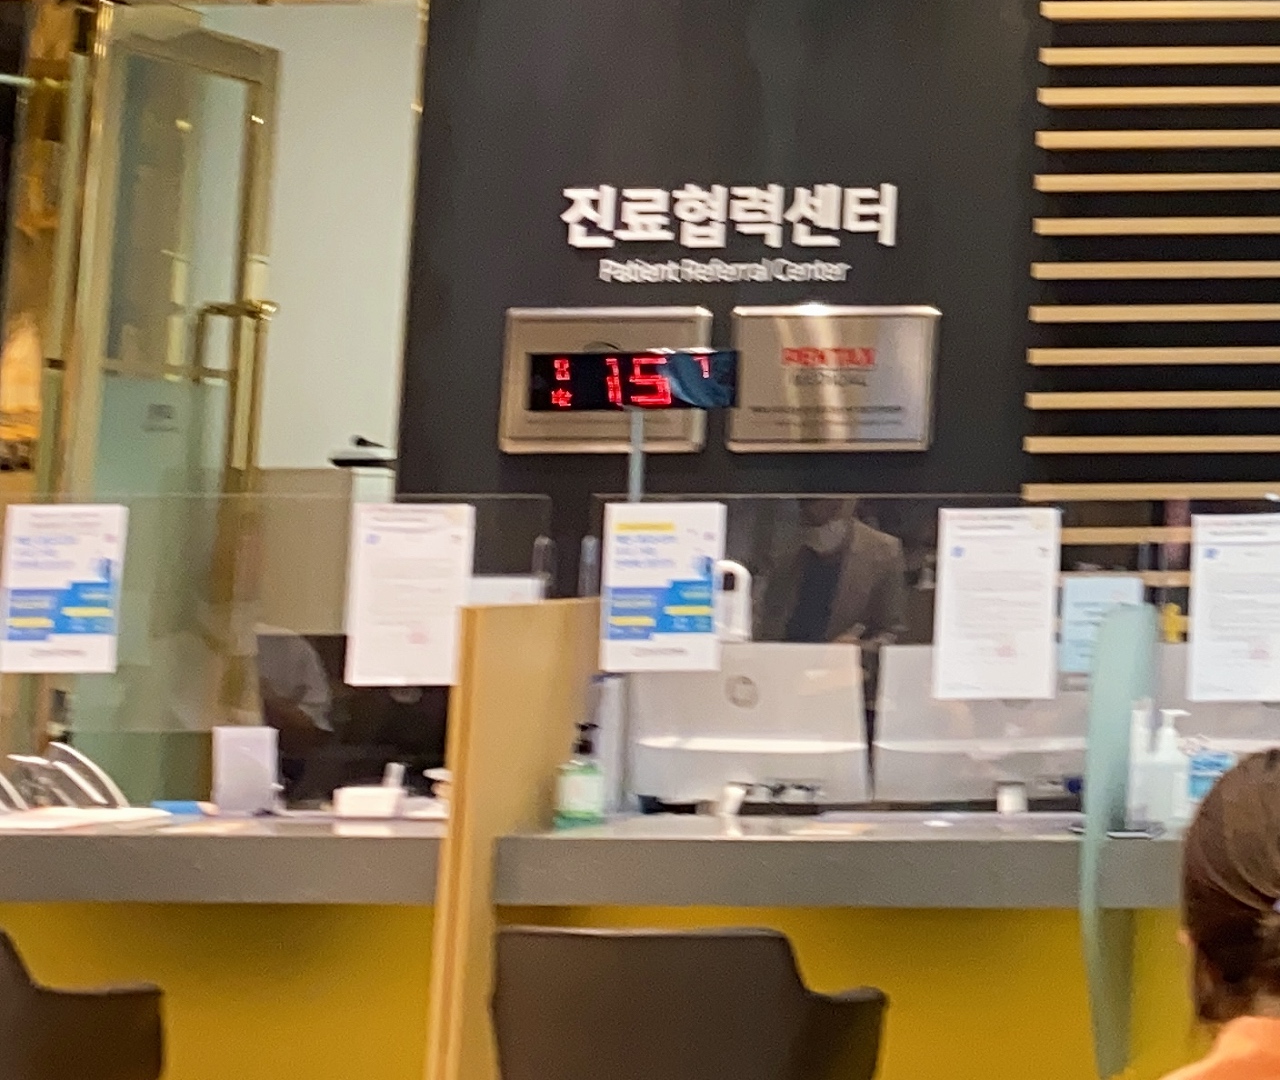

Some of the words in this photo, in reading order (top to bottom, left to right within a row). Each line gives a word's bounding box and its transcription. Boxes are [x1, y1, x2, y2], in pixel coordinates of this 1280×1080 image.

[560, 182, 899, 249] 진료협력센터
[599, 258, 681, 283] Patient
[681, 258, 773, 283] Referral
[772, 258, 852, 282] Center
